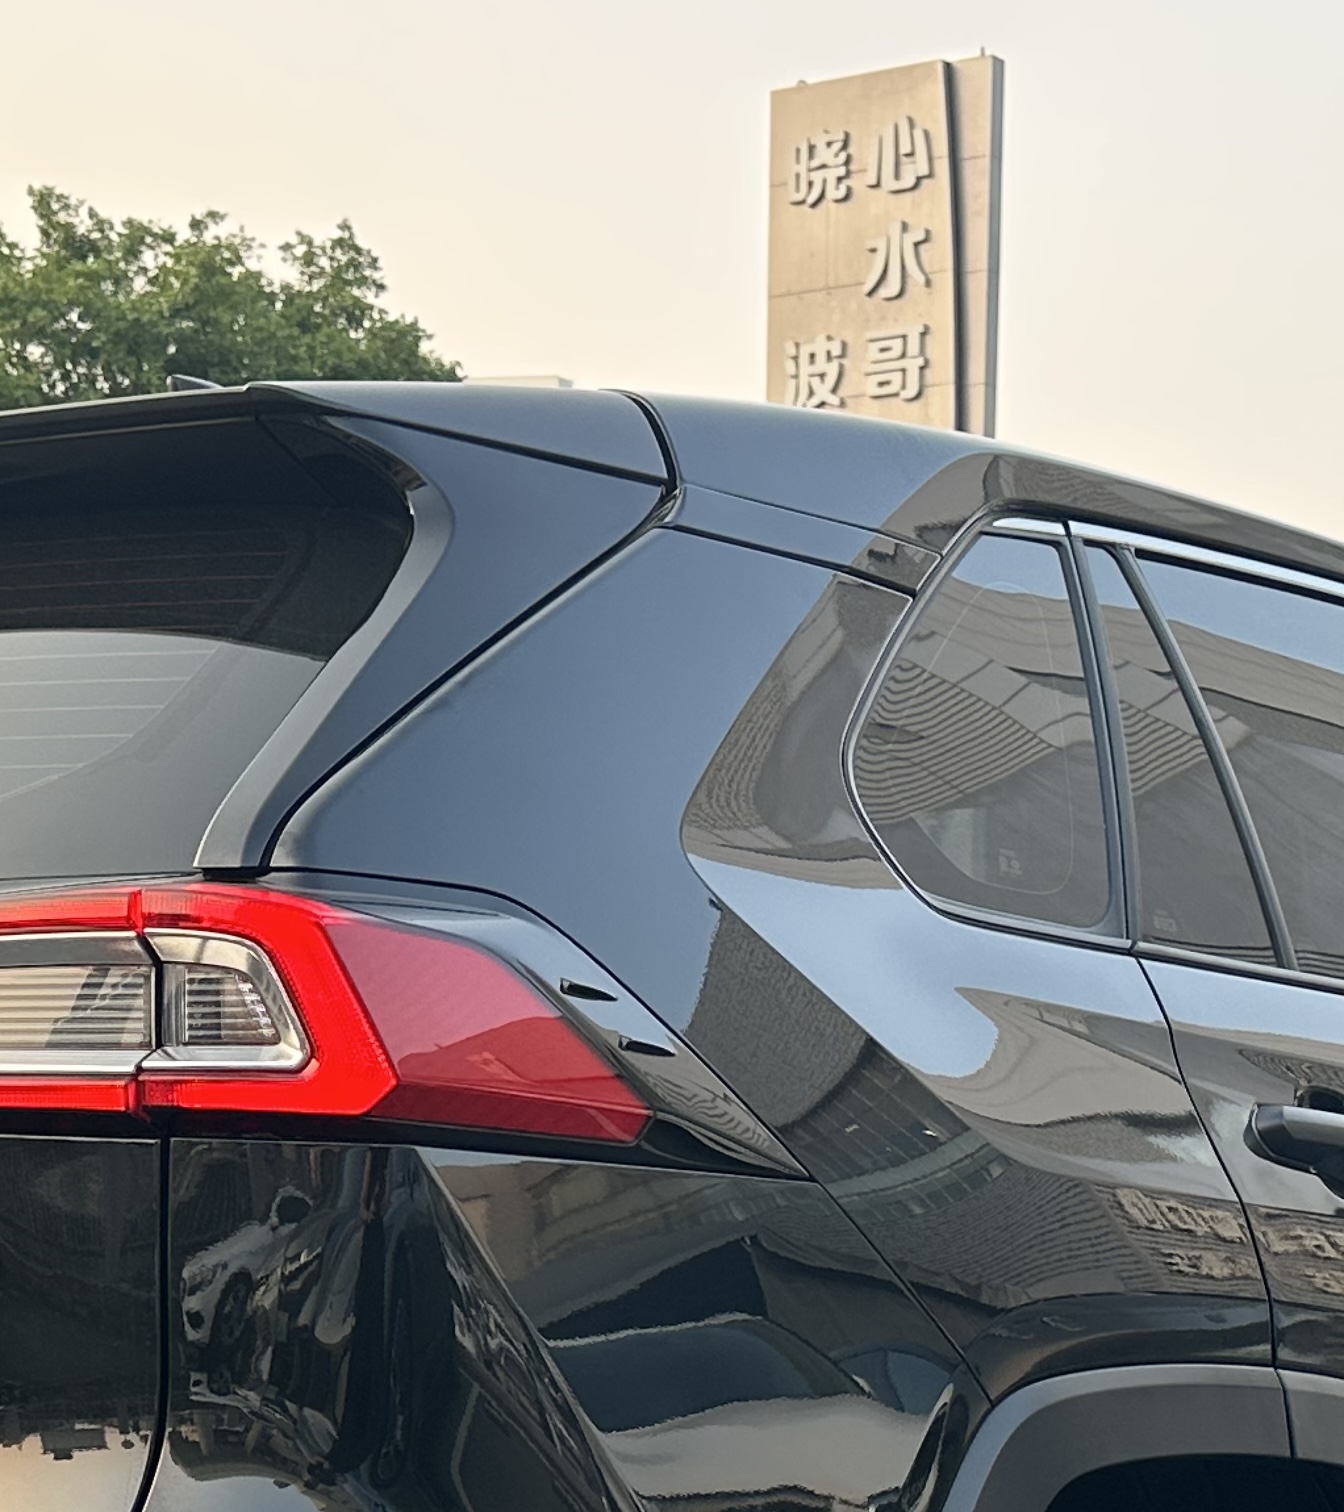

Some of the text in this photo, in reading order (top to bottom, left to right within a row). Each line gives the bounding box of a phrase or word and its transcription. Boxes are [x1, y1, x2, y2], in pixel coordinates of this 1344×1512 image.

[784, 129, 853, 410] 晓波
[865, 114, 935, 402] 心水哥
